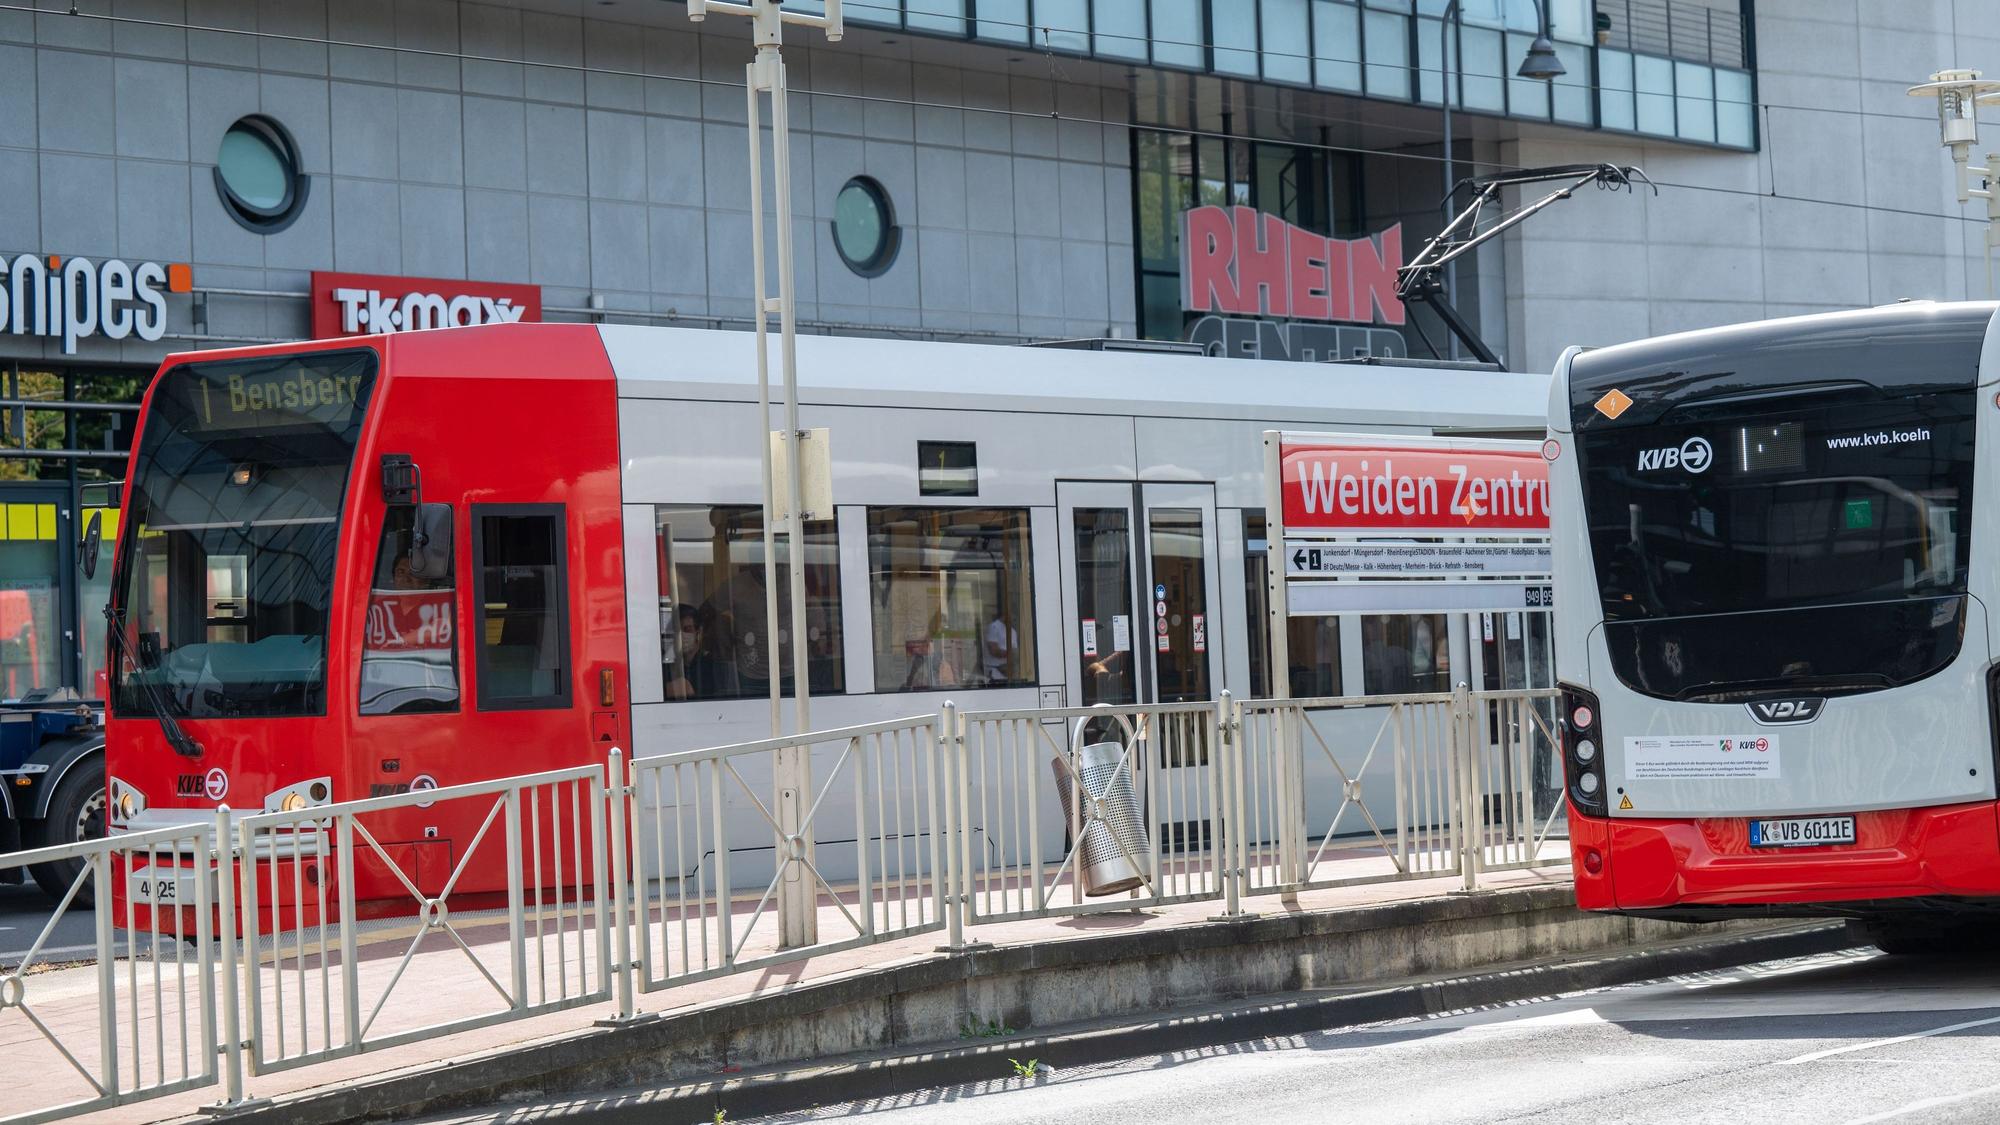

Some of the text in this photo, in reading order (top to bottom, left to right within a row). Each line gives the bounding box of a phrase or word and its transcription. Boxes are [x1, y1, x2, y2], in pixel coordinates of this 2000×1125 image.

[1184, 205, 1405, 325] RHEIN
[0, 254, 168, 355] nipes
[200, 377, 212, 424] 1
[1826, 428, 1931, 449] www.kvb.koeln
[1637, 447, 1680, 471] KVB
[1297, 459, 1438, 515] Weiden
[1323, 548, 1351, 557] Junkersdorf
[1354, 548, 1384, 558] Müngersdorf
[1526, 590, 1540, 603] 949
[1758, 701, 1811, 718] VDL
[1739, 740, 1756, 750] KVB
[176, 774, 206, 793] KVB
[1760, 823, 1770, 842] K
[1781, 822, 1800, 841] VB
[1803, 820, 1851, 840] 6011E
[141, 880, 176, 899] 425
